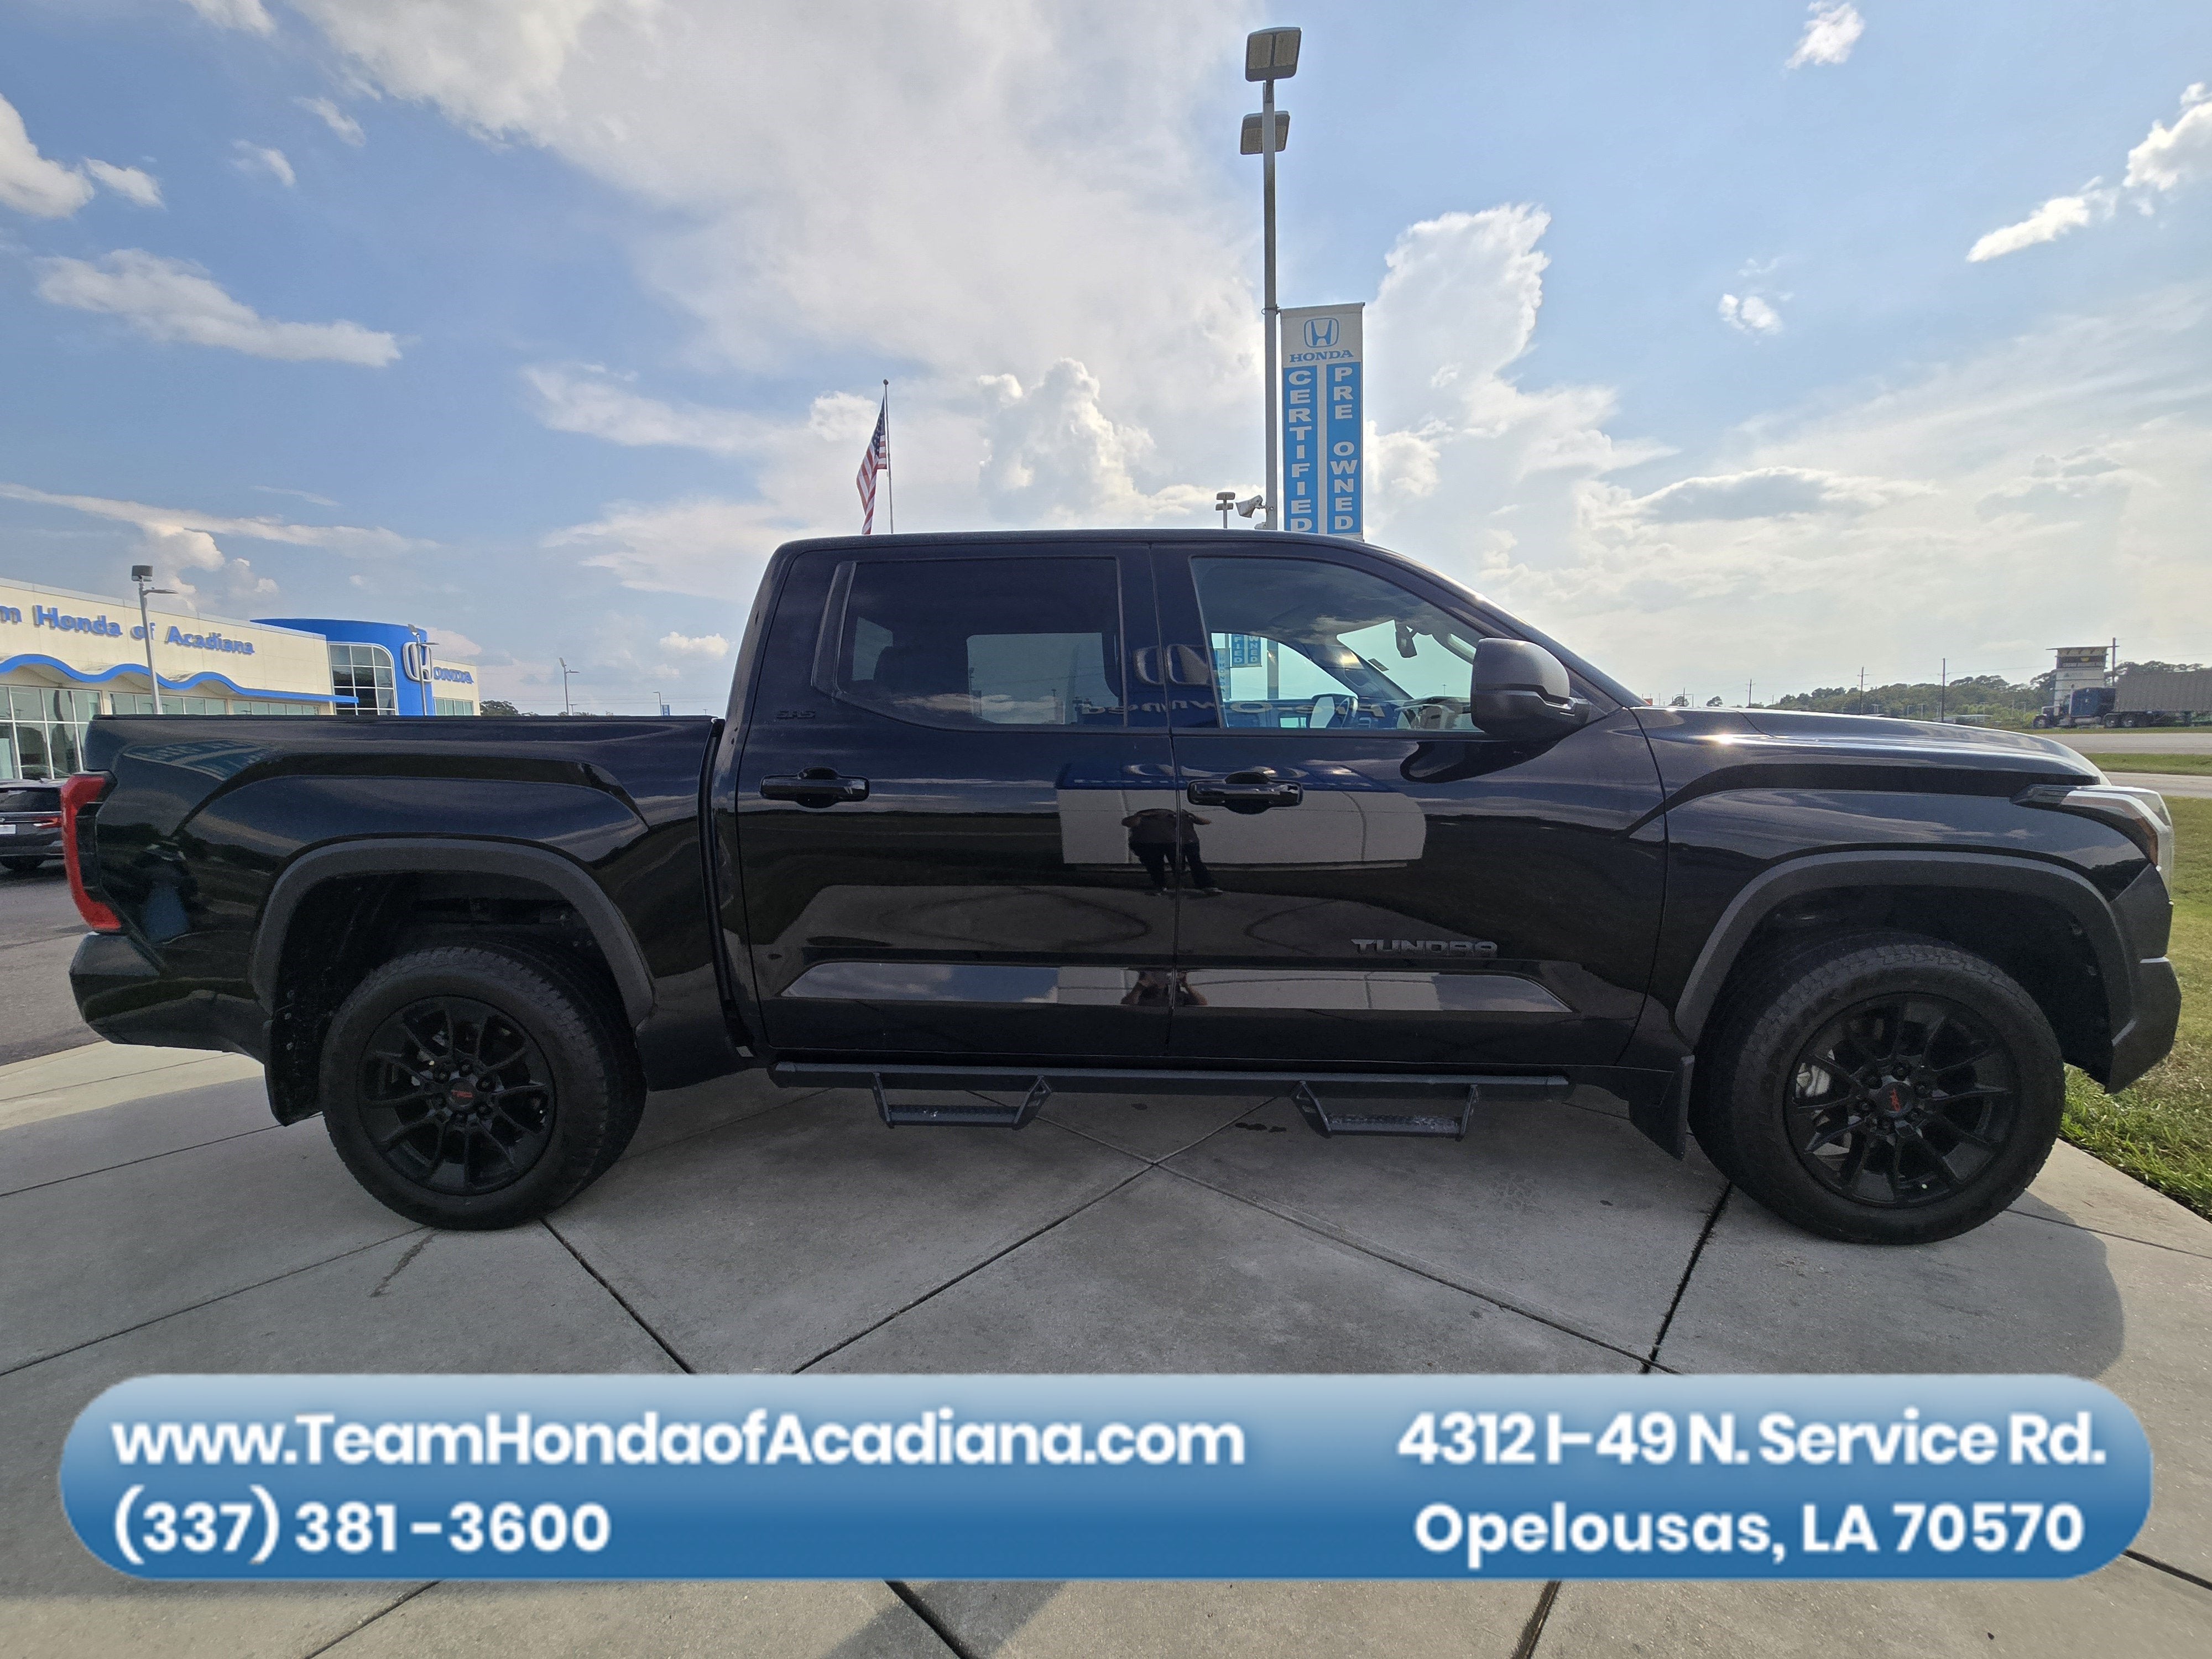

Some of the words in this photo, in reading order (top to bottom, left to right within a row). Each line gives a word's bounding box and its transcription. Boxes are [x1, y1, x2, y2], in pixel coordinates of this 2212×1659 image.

[1290, 349, 1354, 362] HONDA
[1333, 367, 1353, 419] PRE
[1288, 371, 1312, 532] CERTIFIED
[1330, 441, 1358, 530] OWNED
[33, 604, 123, 637] Honda
[164, 625, 255, 655] Acadiana
[1351, 939, 1498, 958] TUNDRA
